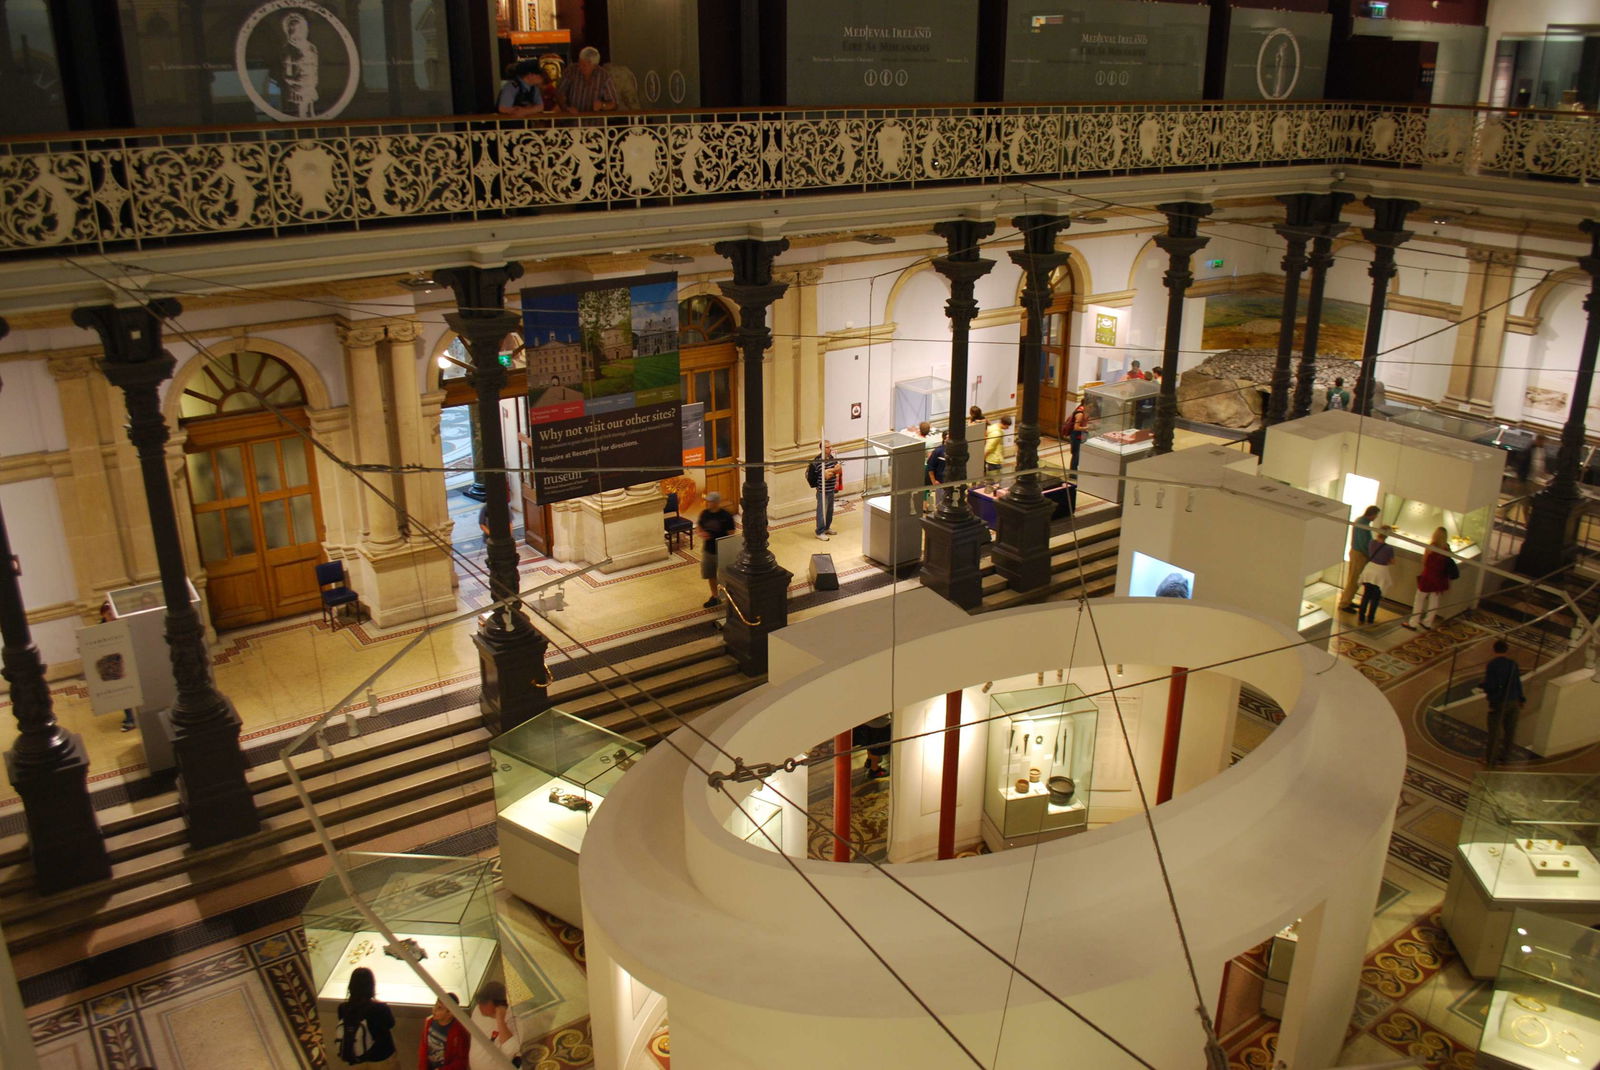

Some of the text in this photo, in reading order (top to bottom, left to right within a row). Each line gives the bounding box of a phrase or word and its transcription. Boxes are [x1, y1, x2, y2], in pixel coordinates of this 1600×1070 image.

[892, 27, 932, 39] IRELAND
[539, 428, 563, 443] Why
[566, 426, 583, 438] not
[584, 421, 605, 435] visit
[607, 418, 624, 430] our
[625, 412, 650, 427] other
[652, 407, 676, 421] sites?
[541, 452, 564, 463] Enquire
[565, 451, 572, 459] at
[572, 447, 601, 459] Reception
[601, 444, 610, 453] for
[543, 471, 582, 485] museum
